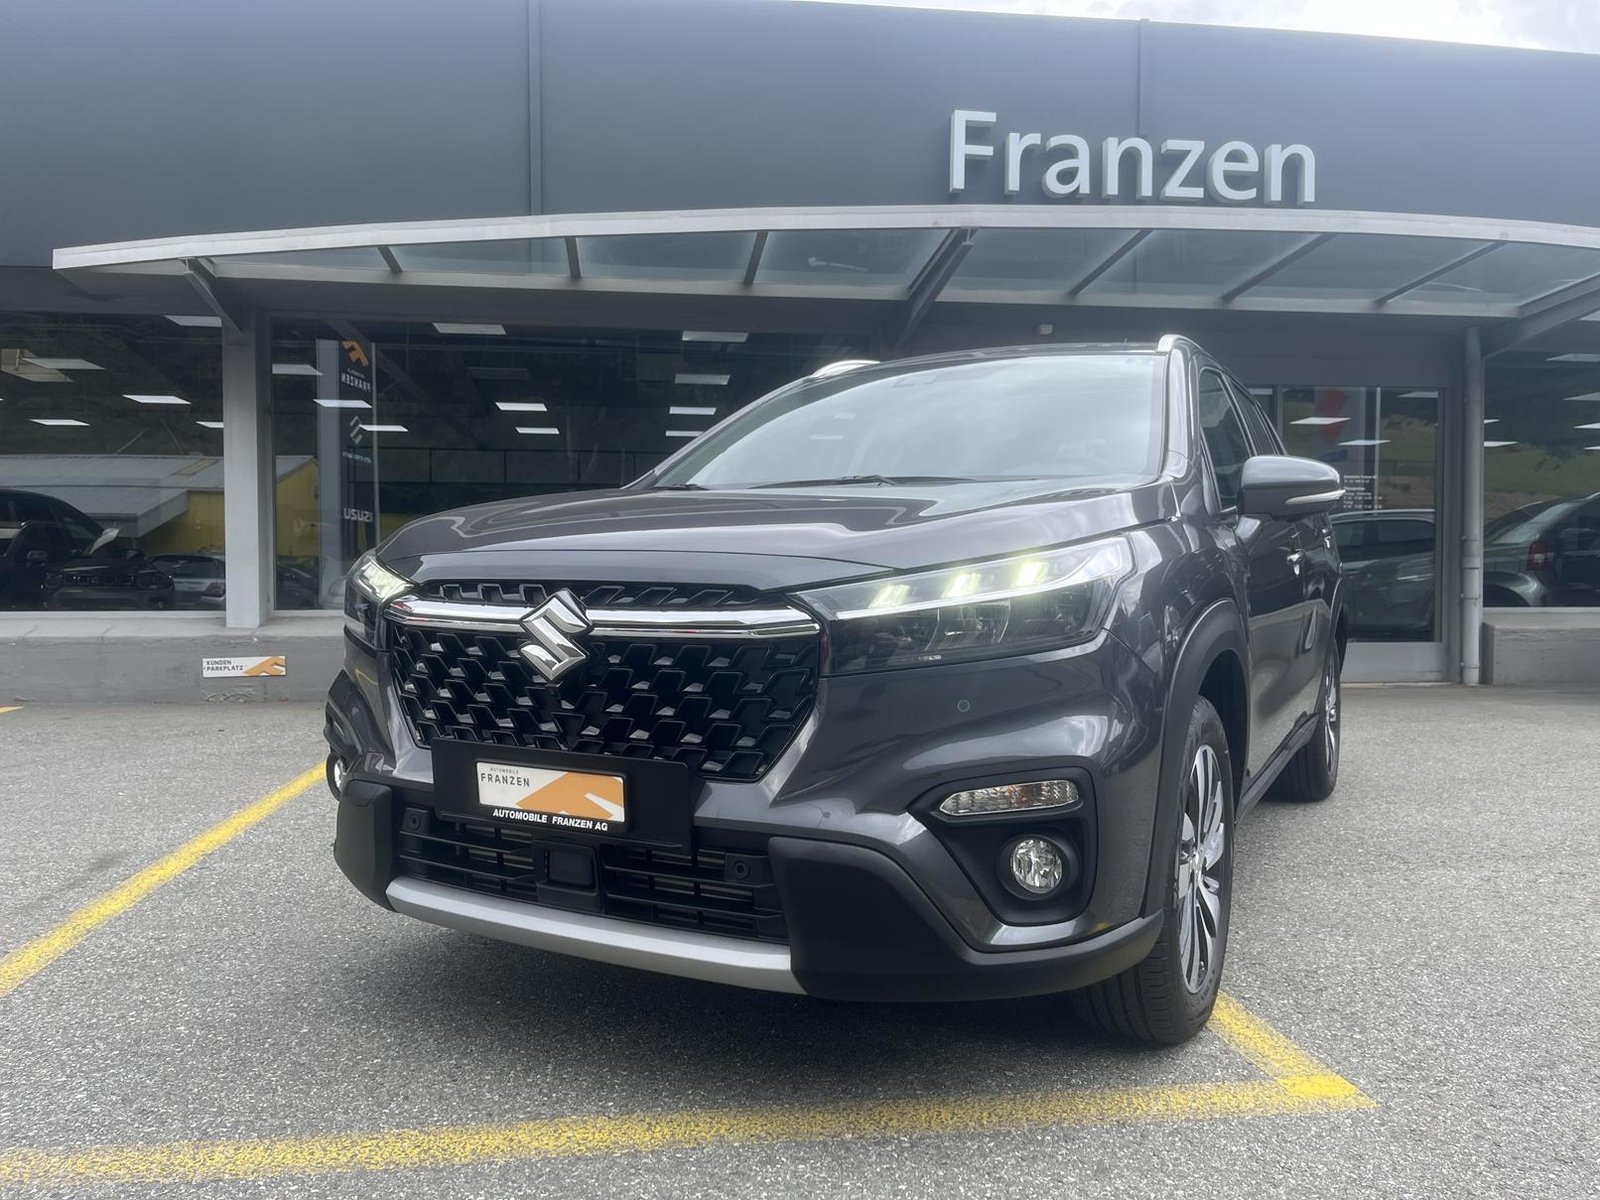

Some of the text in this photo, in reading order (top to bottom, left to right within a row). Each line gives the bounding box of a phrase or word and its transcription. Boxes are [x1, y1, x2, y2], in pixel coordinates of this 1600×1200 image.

[949, 109, 1316, 206] Franzen
[480, 773, 530, 787] FRANZEN
[493, 809, 608, 831] AUTOMOBILE FRANZEN AG
